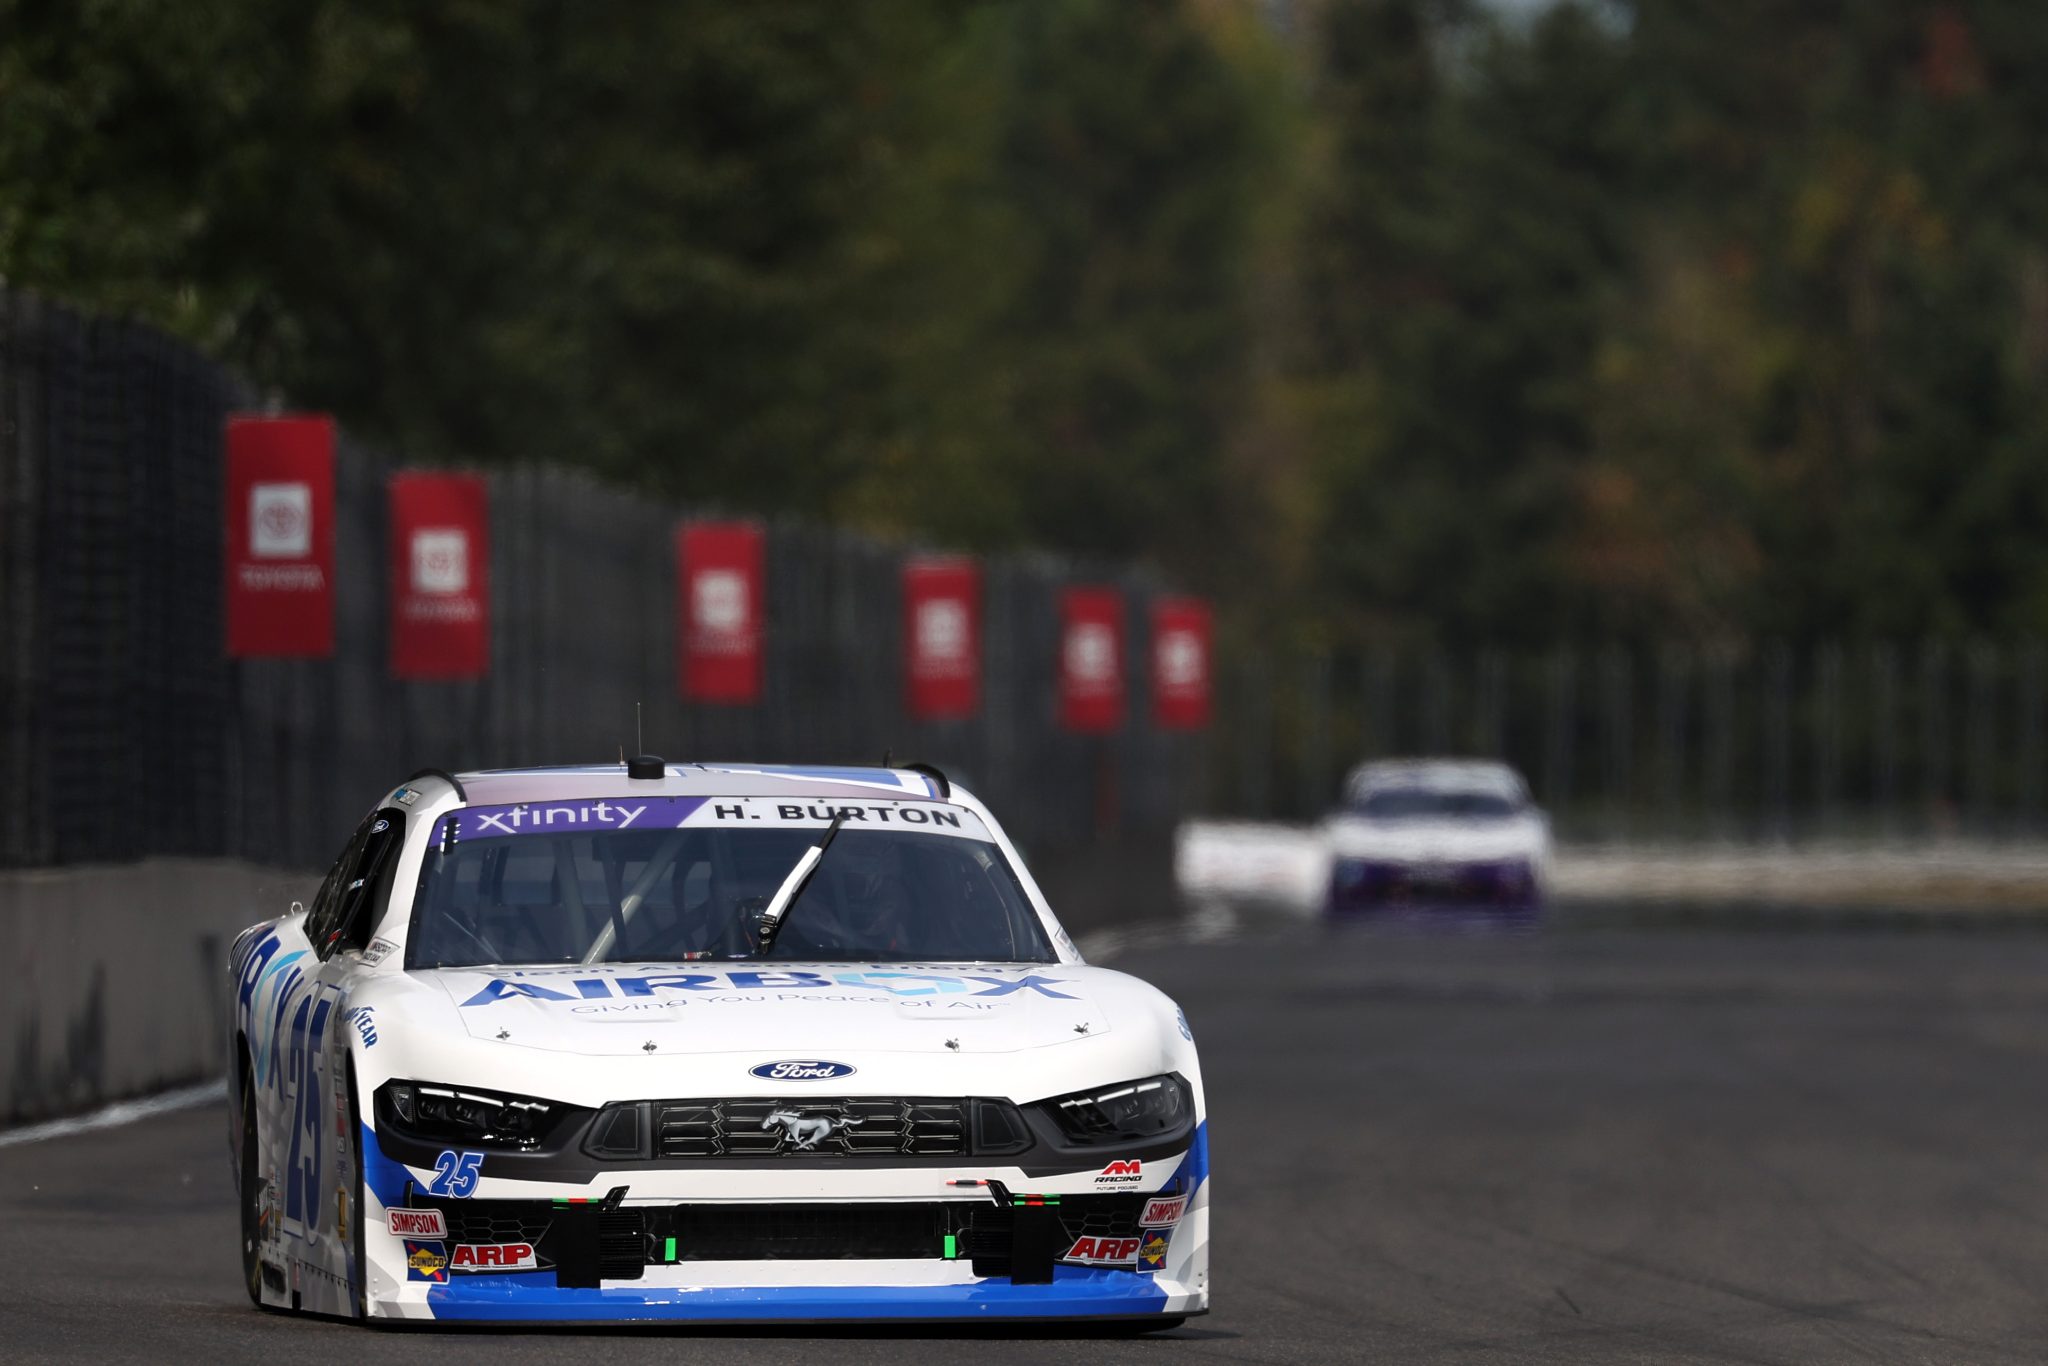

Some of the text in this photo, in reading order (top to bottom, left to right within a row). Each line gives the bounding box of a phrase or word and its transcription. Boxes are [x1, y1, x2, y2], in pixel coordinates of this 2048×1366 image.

[477, 801, 647, 834] xfinity
[714, 803, 961, 829] H. BURTON
[459, 971, 1083, 1006] AIRBOX
[570, 999, 687, 1014] Giving
[777, 994, 890, 1003] Peace
[769, 1062, 836, 1079] Ford
[284, 982, 342, 1245] 25
[428, 1150, 485, 1199] 25
[1101, 1161, 1141, 1175] AM
[1094, 1175, 1143, 1183] RACING
[391, 1212, 441, 1234] SIMPSON
[453, 1245, 532, 1265] ARP
[1068, 1238, 1140, 1259] ARP
[410, 1256, 445, 1268] SUNOCO
